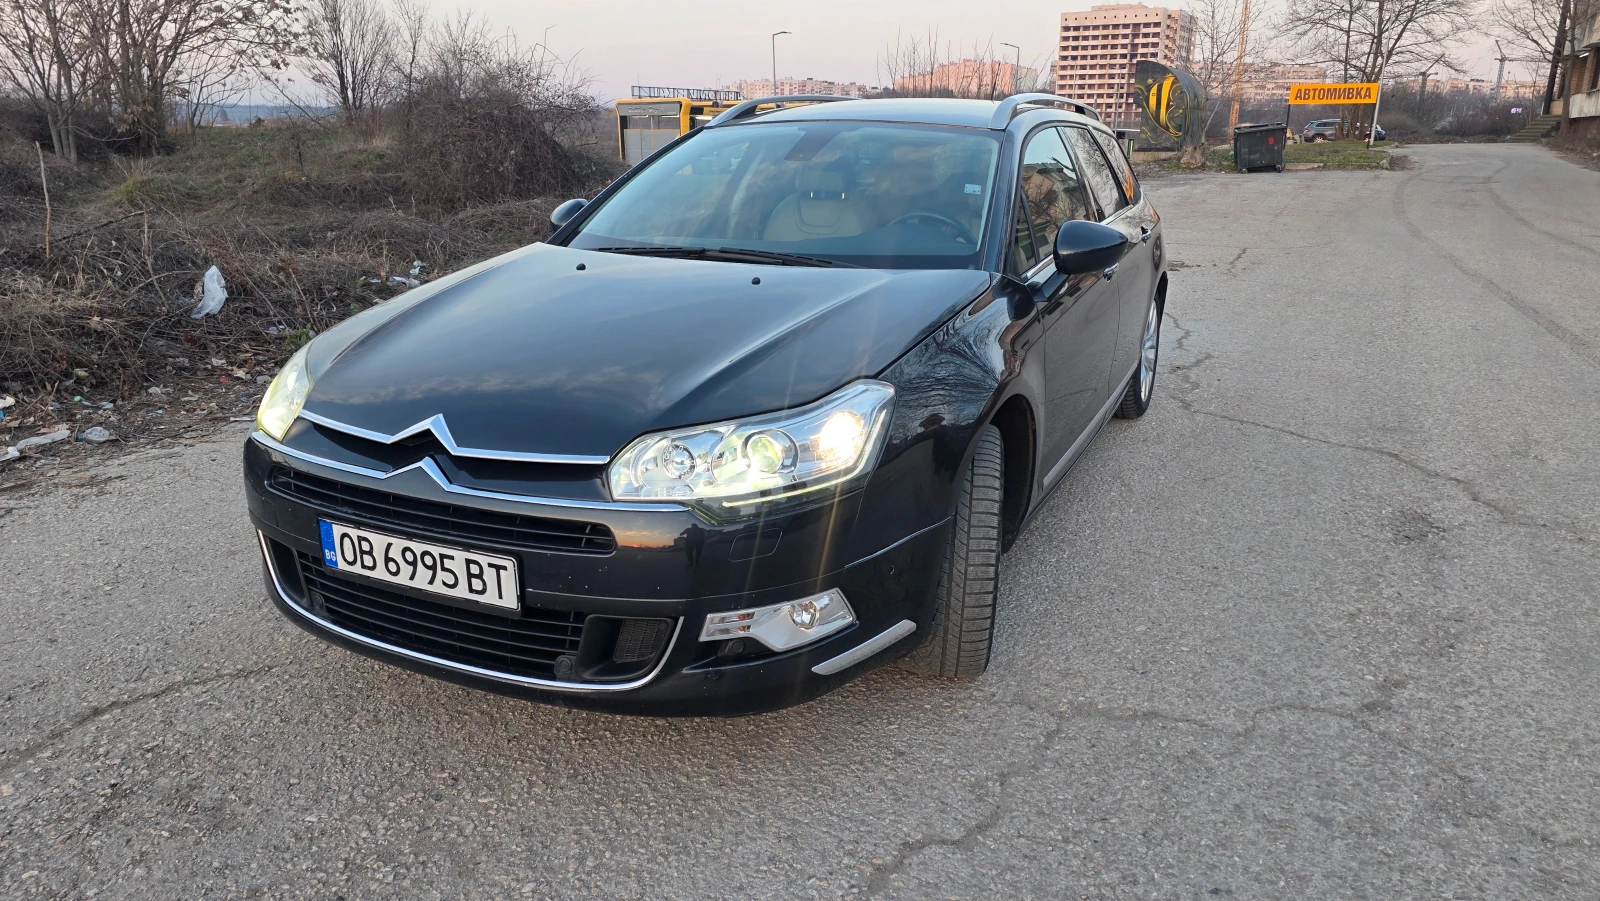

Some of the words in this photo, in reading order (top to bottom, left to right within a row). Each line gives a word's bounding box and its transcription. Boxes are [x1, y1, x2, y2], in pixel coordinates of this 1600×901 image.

[1294, 86, 1372, 101] АВТОМИВКА
[324, 549, 336, 562] BG
[339, 532, 377, 572] OB
[384, 542, 459, 589] 6995
[465, 557, 508, 600] BT
